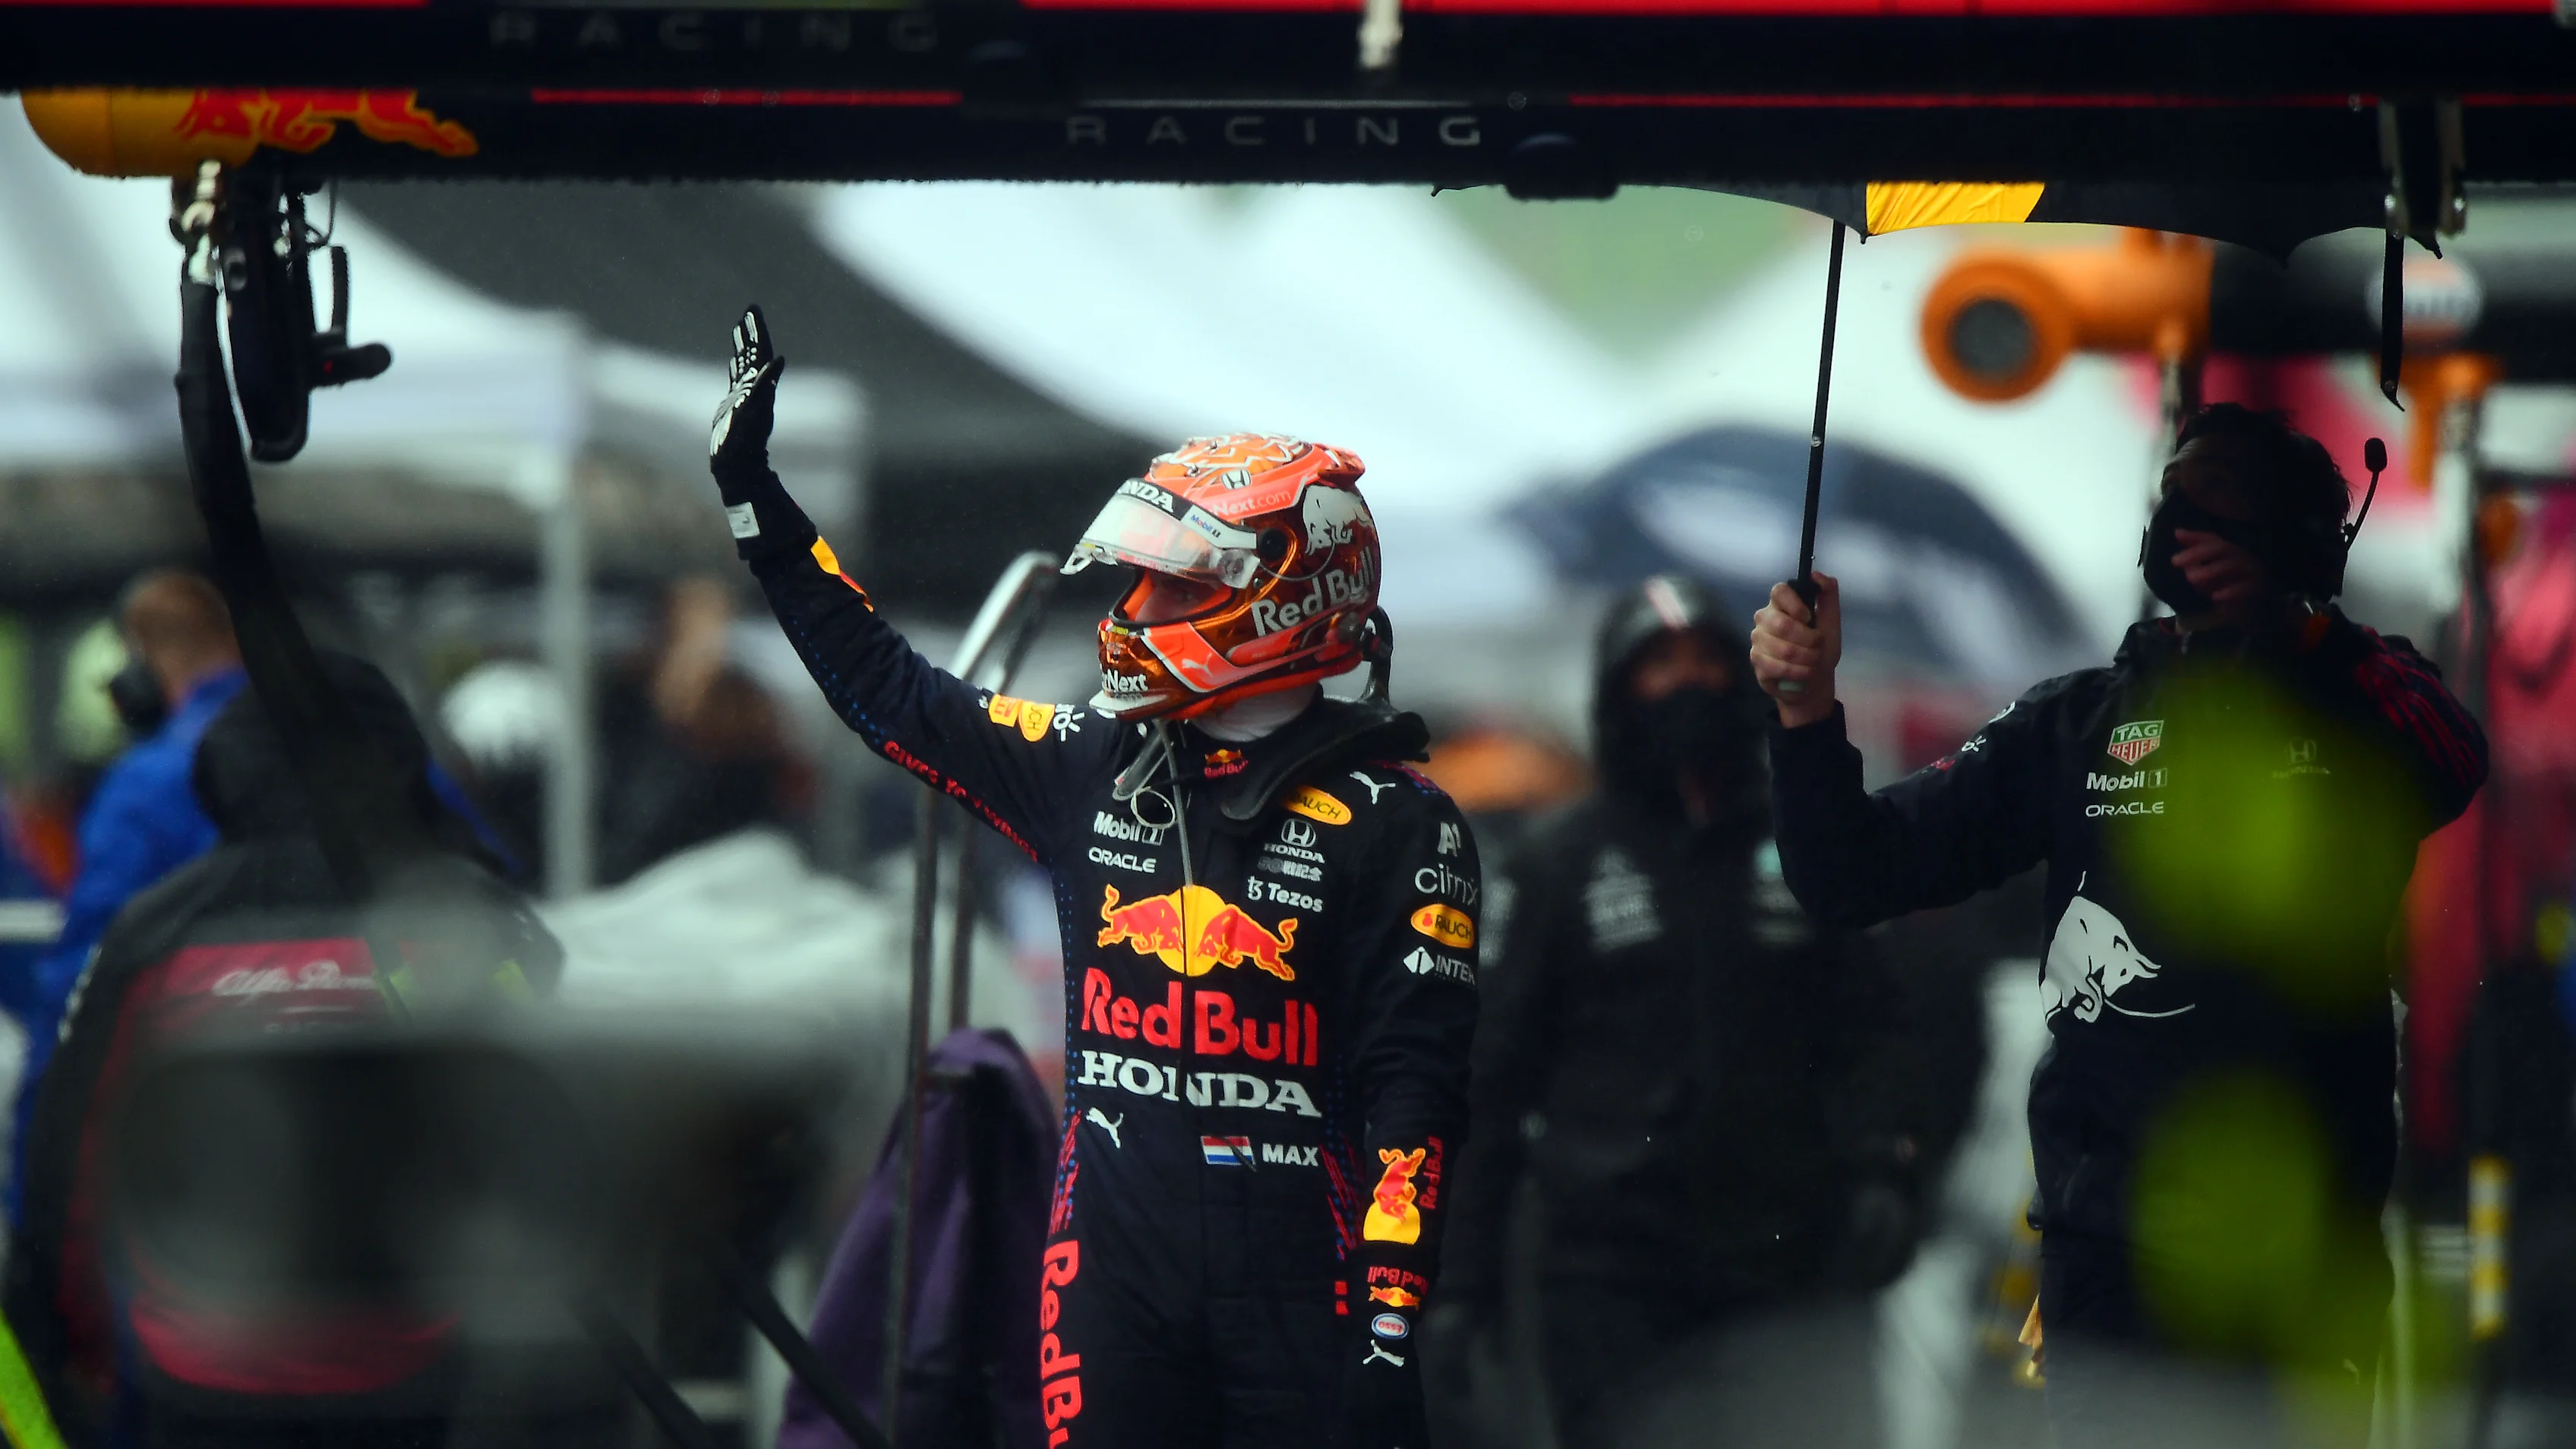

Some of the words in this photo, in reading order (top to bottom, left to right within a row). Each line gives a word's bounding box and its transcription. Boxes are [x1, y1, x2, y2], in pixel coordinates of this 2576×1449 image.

[1065, 115, 1482, 145] RACING
[1117, 480, 1174, 513] NDA
[1251, 575, 1324, 638] Red
[1325, 546, 1375, 607] Bull
[2116, 722, 2161, 743] TAG
[2110, 738, 2161, 763] HEUER
[2086, 771, 2146, 793] Mobil
[1299, 796, 1342, 819] AUCH
[2085, 801, 2164, 818] ORACLE
[1094, 811, 1140, 842] Mobil
[1088, 847, 1157, 873] ORACLE
[1263, 843, 1325, 864] HONDA
[1267, 882, 1324, 912] Tezos
[1435, 914, 1472, 939] RAUCH
[1081, 968, 1182, 1049] Red
[1195, 990, 1318, 1065] Bull
[1077, 1050, 1323, 1118] HONDA
[1262, 1143, 1319, 1167] MAX
[1040, 1240, 1081, 1381] Red
